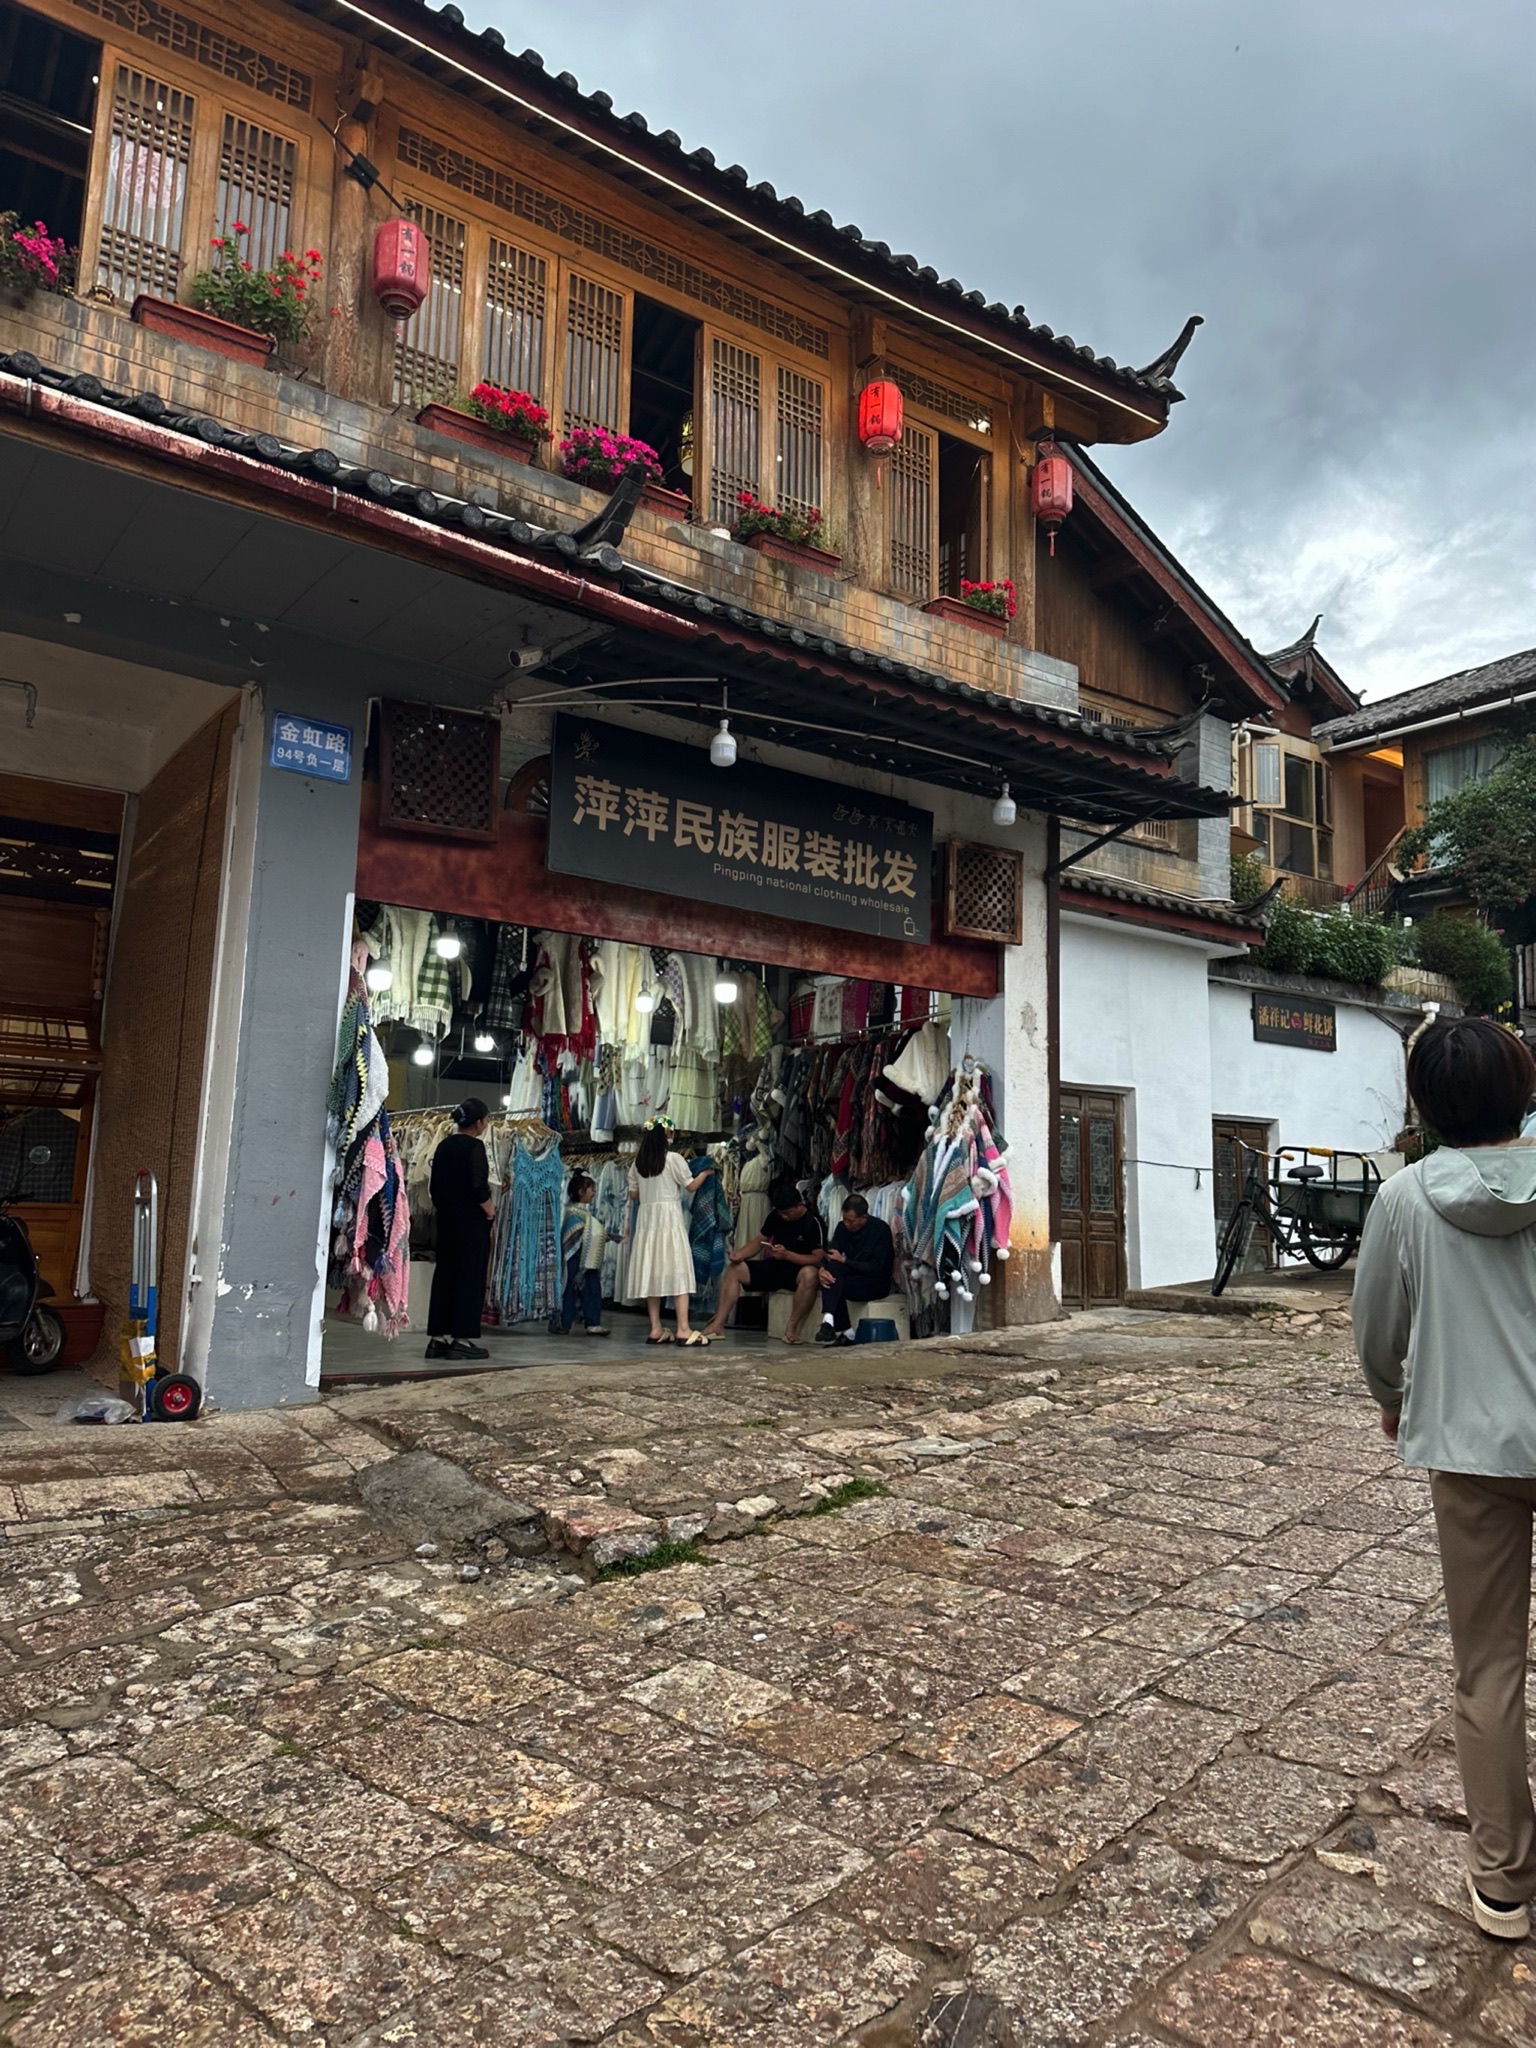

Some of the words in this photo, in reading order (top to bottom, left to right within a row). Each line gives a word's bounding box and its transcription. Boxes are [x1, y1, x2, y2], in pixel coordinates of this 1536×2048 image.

[279, 721, 347, 755] 金虹路
[276, 747, 345, 774] 94号负一层
[572, 774, 919, 900] 萍萍民族服装批发
[712, 863, 764, 887] Pingping
[766, 876, 812, 894] national
[813, 885, 858, 907] clothing
[859, 897, 911, 916] wholesale
[1303, 1011, 1334, 1037] 鲜花饼
